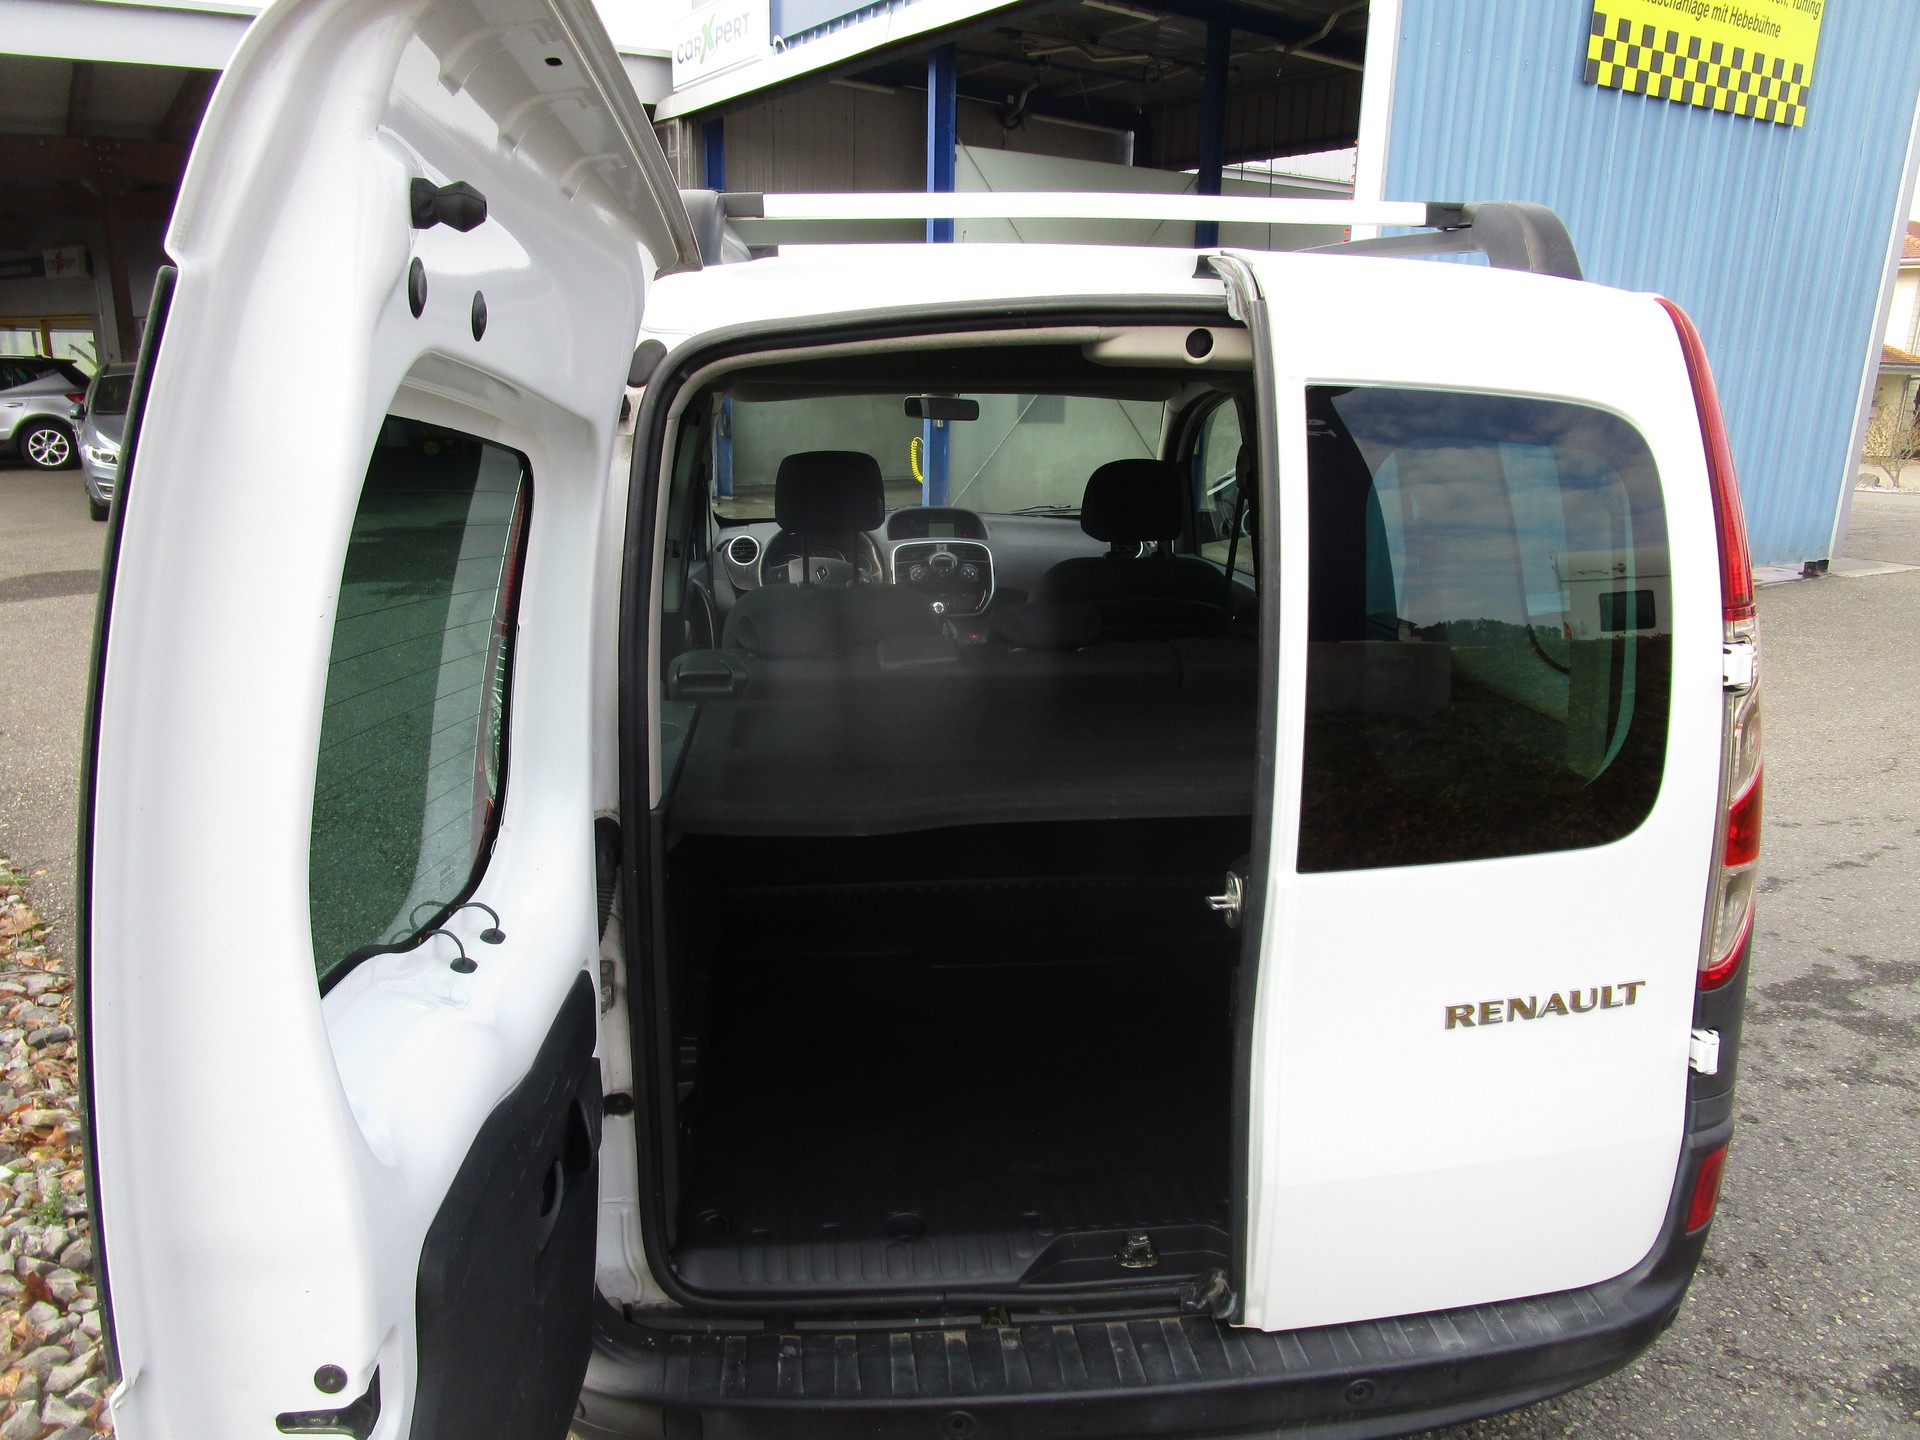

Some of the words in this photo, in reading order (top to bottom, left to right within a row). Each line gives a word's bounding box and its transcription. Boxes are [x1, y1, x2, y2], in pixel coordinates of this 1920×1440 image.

[1642, 0, 1710, 22] chanlage
[1710, 5, 1729, 23] mit
[1730, 7, 1782, 38] Hebebühne
[1444, 979, 1646, 1031] RENAULT
